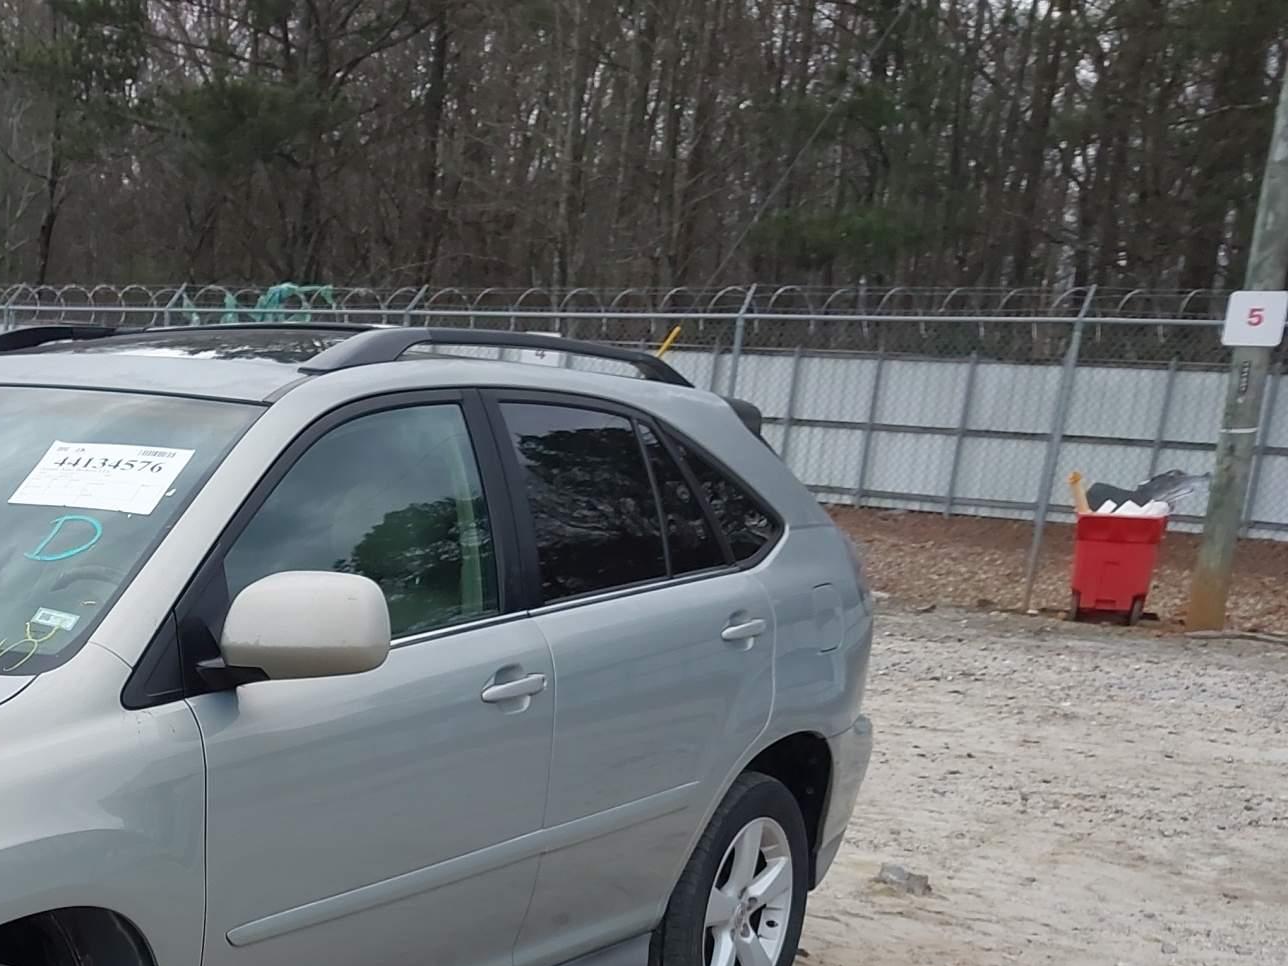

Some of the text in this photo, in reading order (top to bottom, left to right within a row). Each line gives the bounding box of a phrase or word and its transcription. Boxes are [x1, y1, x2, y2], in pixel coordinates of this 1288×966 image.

[1247, 307, 1265, 327] 5
[53, 456, 166, 473] 44134576
[23, 514, 103, 561] D
